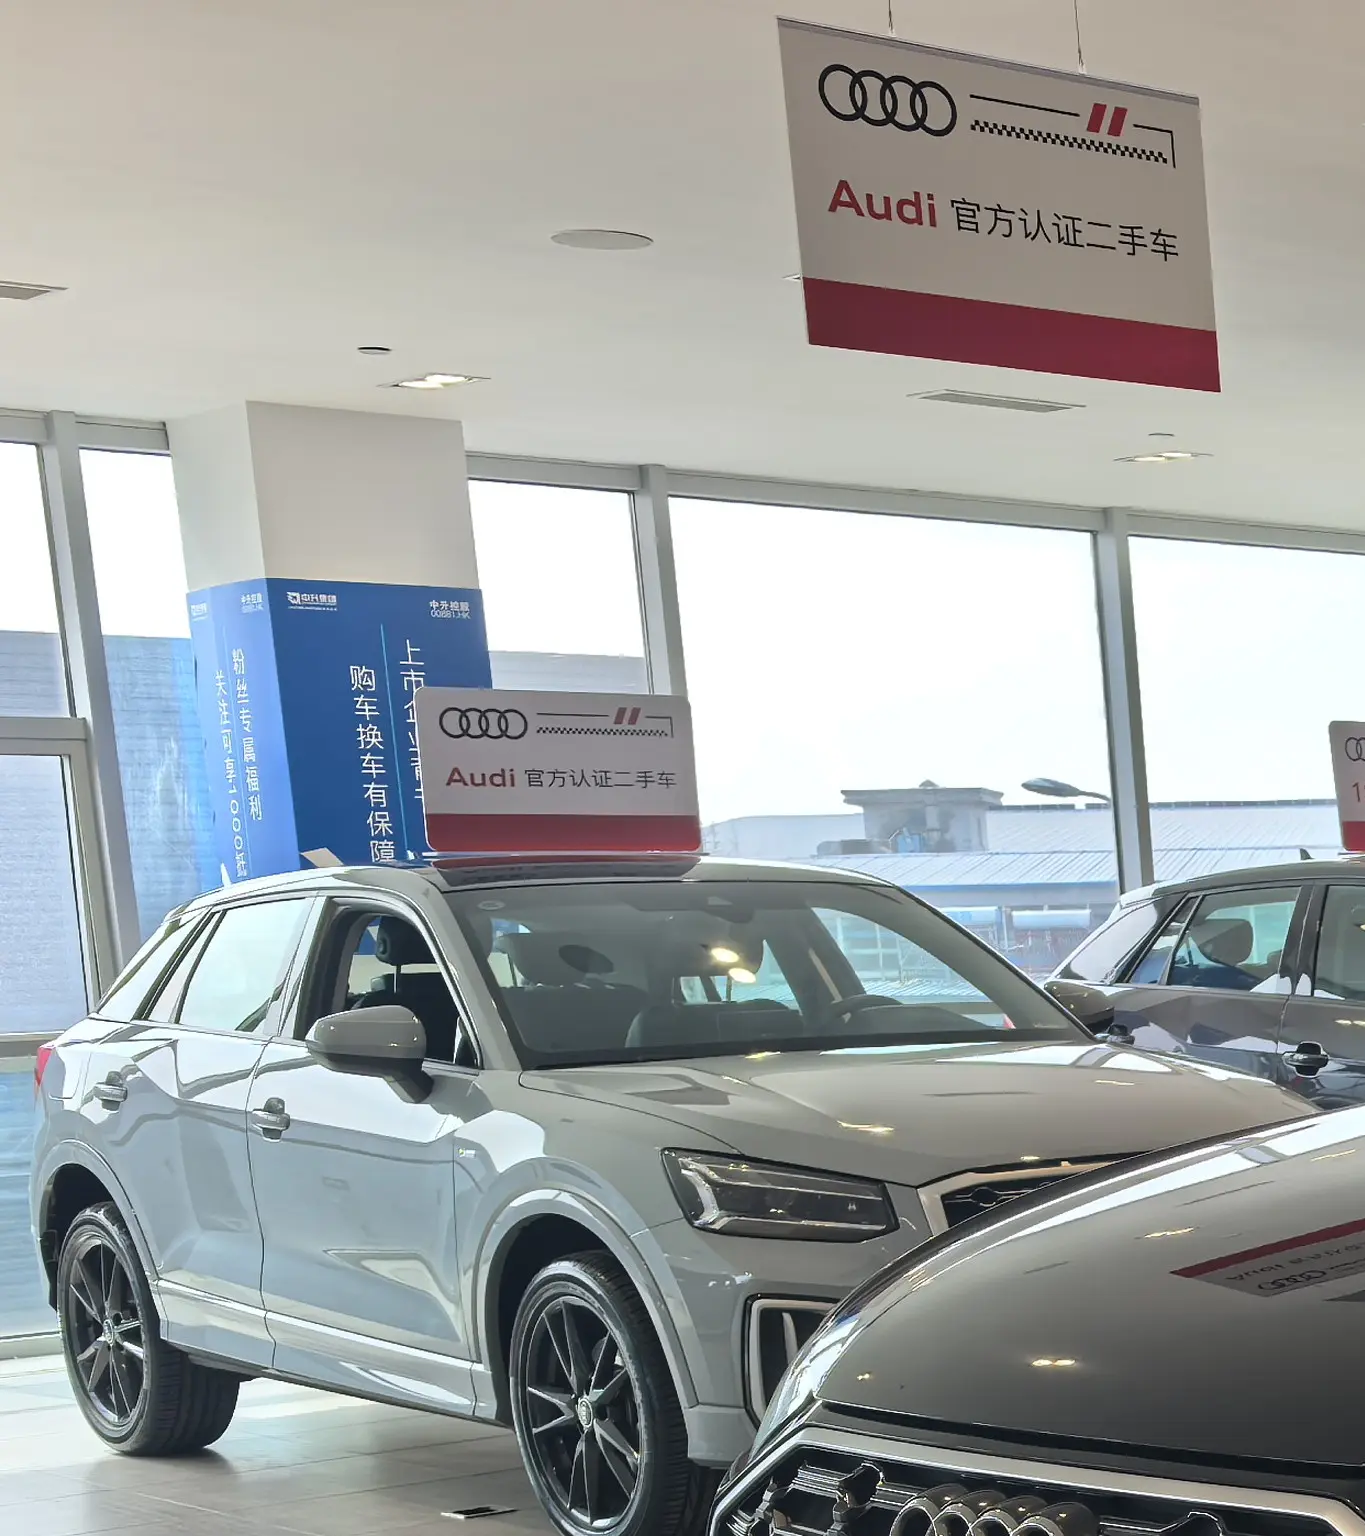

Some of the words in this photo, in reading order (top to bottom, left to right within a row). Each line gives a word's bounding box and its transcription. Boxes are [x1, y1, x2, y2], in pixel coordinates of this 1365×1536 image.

[828, 179, 938, 228] Audi
[950, 197, 1179, 262] 官方认证二手车
[232, 648, 262, 821] 粉丝专属福利
[350, 665, 396, 863] 购车换车有保障
[446, 767, 515, 788] Audi
[524, 768, 677, 789] 官方认证二手车
